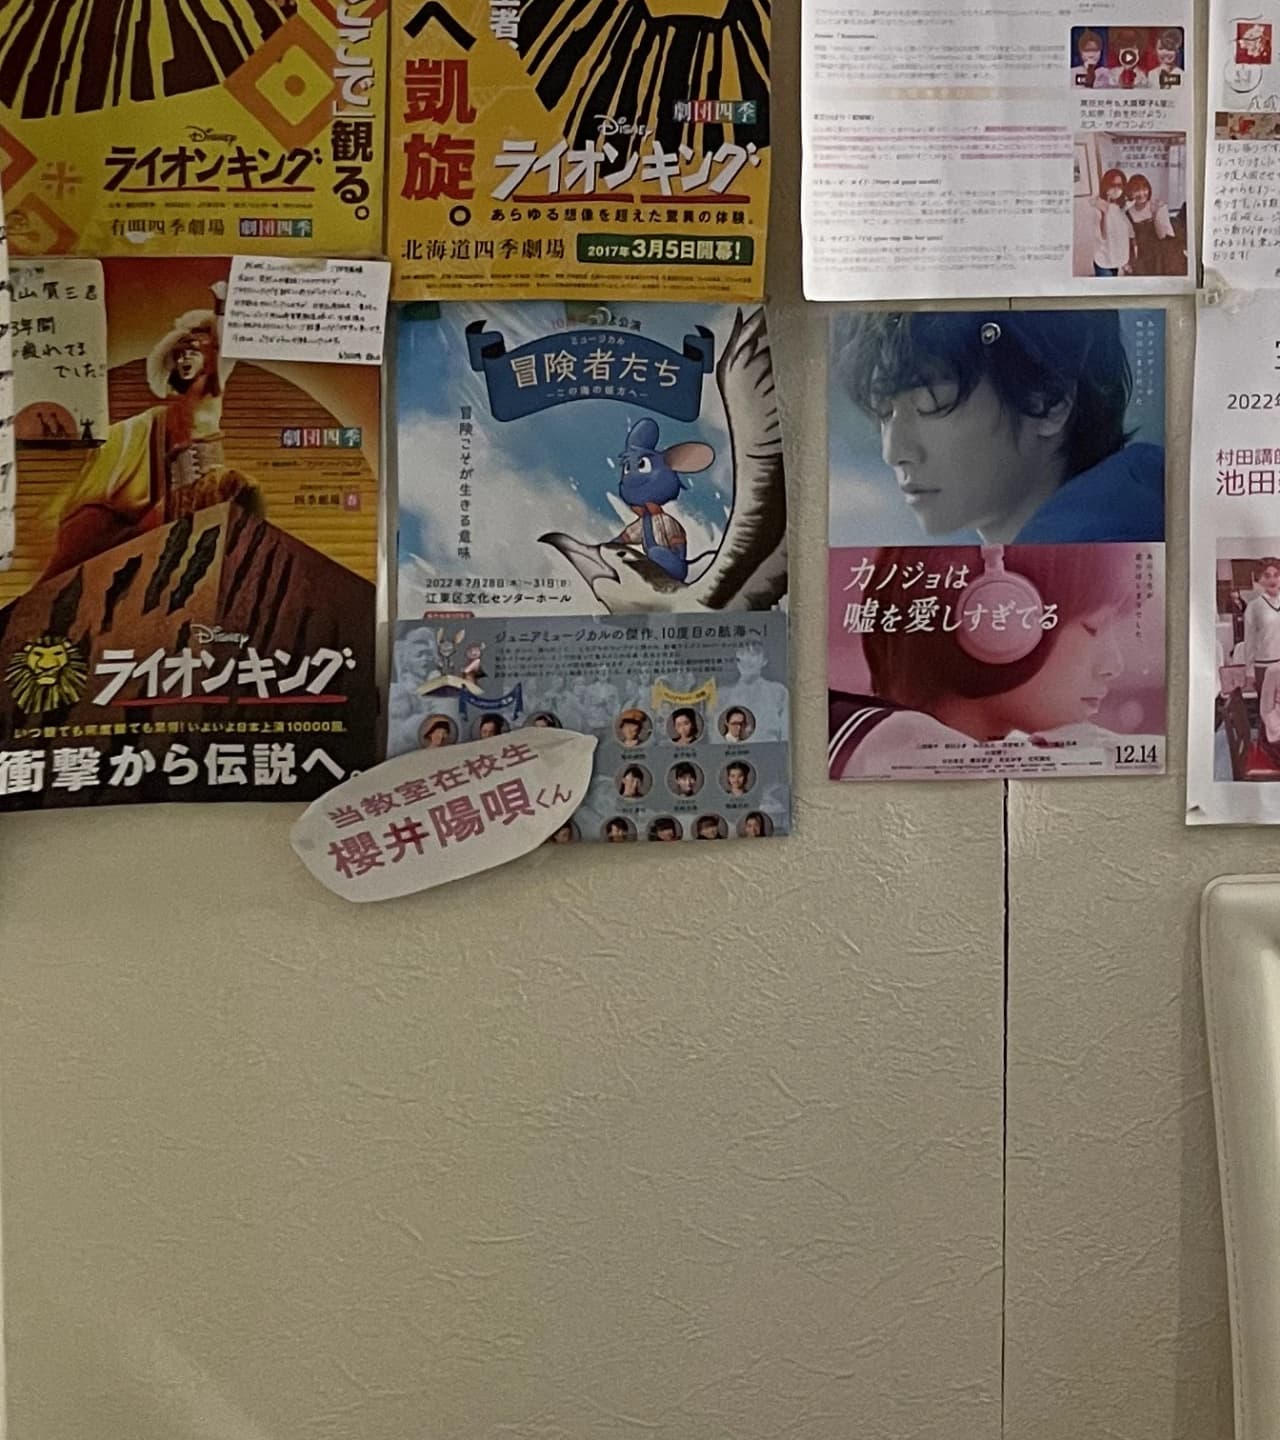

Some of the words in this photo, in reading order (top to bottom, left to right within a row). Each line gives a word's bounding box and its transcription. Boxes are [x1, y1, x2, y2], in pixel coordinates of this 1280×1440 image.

[673, 100, 757, 125] 劇団四季
[105, 146, 323, 191] ライオンキング
[491, 140, 760, 201] ライオンキング
[239, 218, 312, 238] 劇団四季
[402, 239, 565, 261] 北海道四季劇場
[510, 349, 680, 389] 冒険者たち
[281, 427, 362, 448] 劇団四季
[844, 557, 970, 592] カノジョは
[842, 596, 1060, 634] 嘘を愛しすぎてる
[93, 647, 356, 706] ライオンキング
[1115, 744, 1158, 765] 12.14
[326, 742, 538, 829] 当教室在校生
